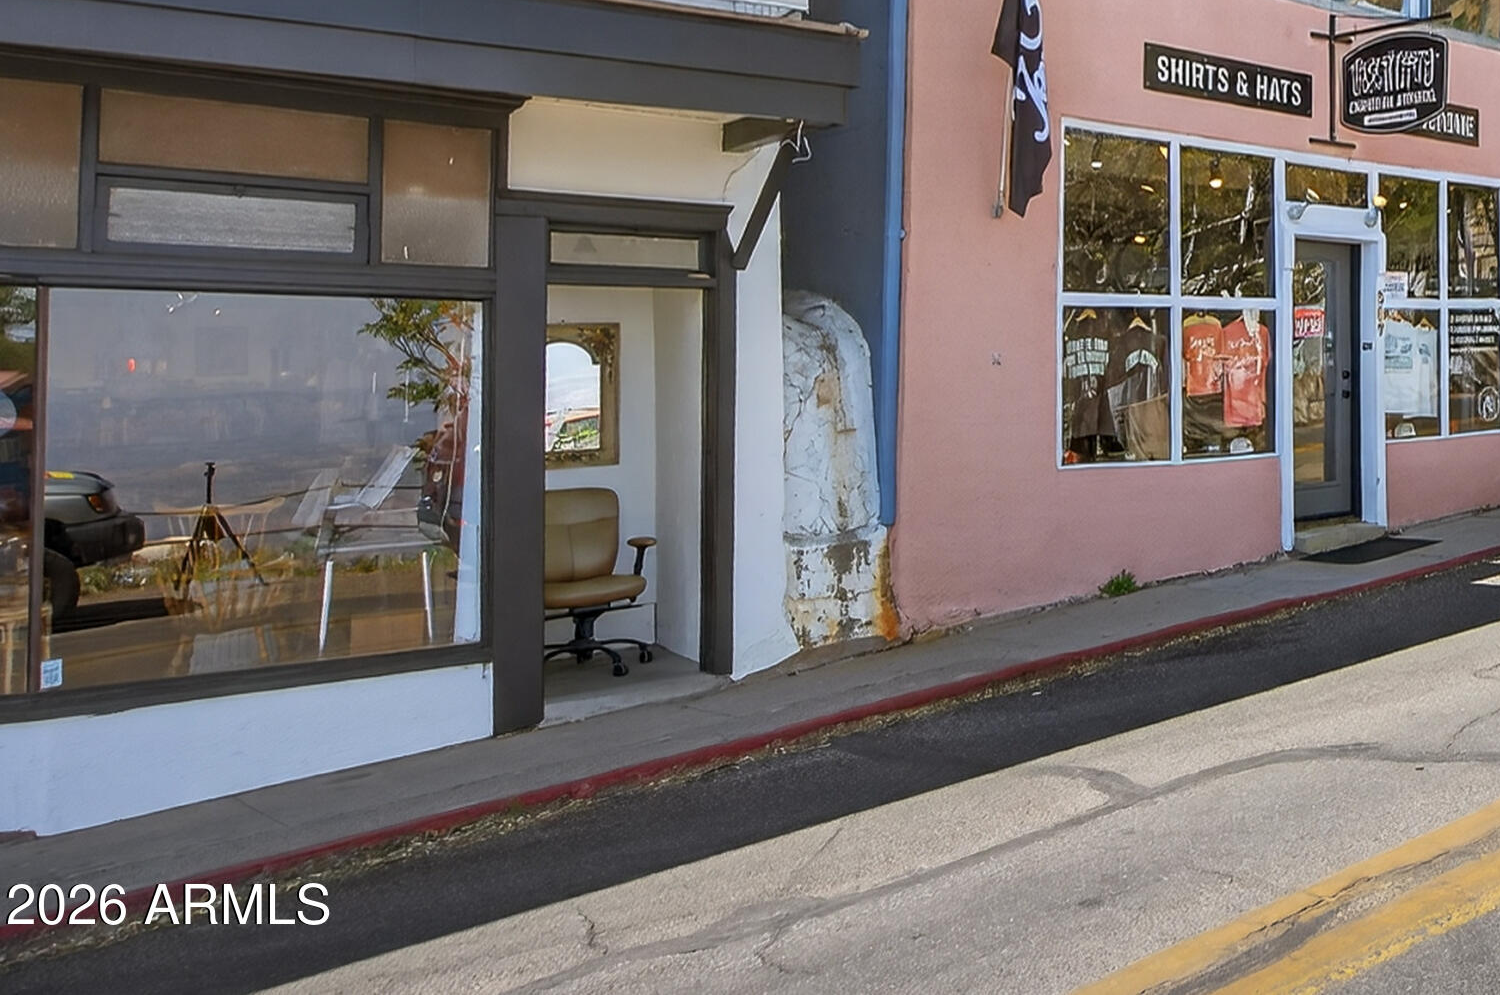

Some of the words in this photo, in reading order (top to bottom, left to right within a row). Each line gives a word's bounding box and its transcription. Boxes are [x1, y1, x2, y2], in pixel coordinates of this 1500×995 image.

[1157, 55, 1230, 92] SHIRTS
[1236, 72, 1250, 97] &
[1256, 77, 1302, 106] HATS
